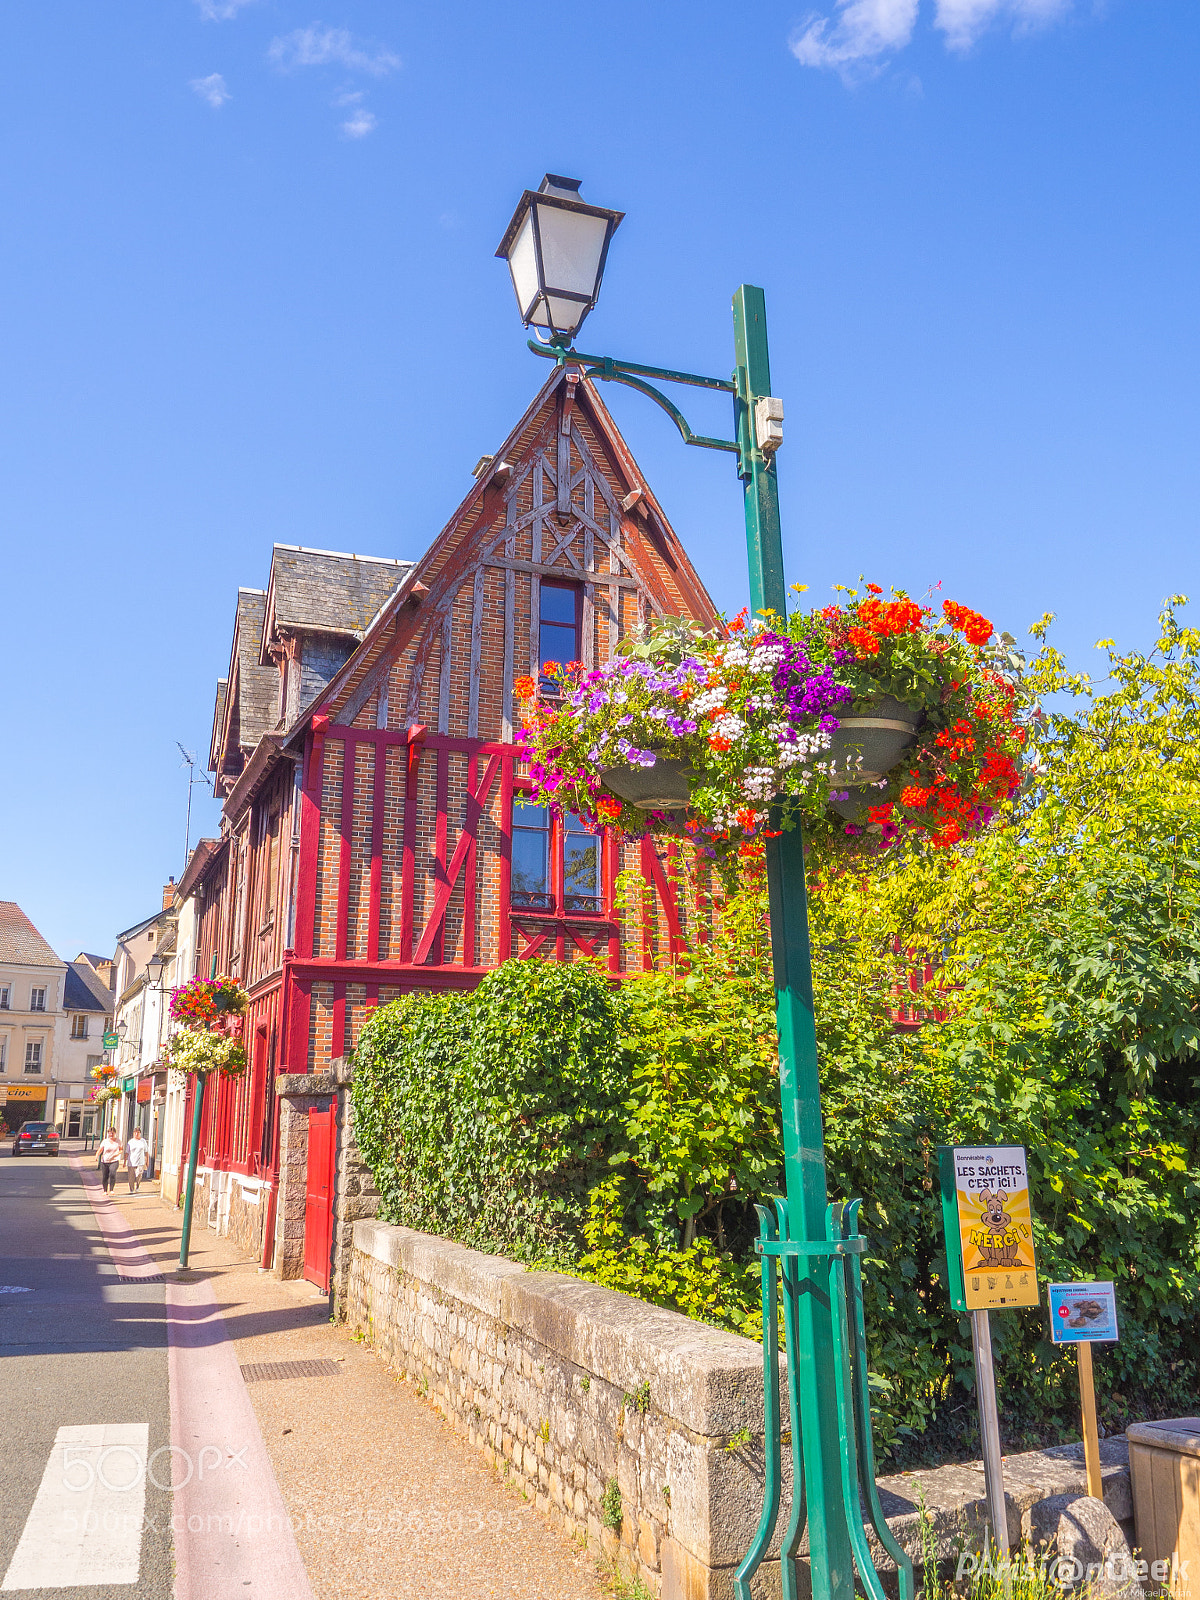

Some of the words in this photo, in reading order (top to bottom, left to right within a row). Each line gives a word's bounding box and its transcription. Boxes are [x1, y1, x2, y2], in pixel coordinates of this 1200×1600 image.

[6, 1088, 32, 1097] cine
[957, 1166, 975, 1177] LES
[968, 1178, 995, 1188] C'EST
